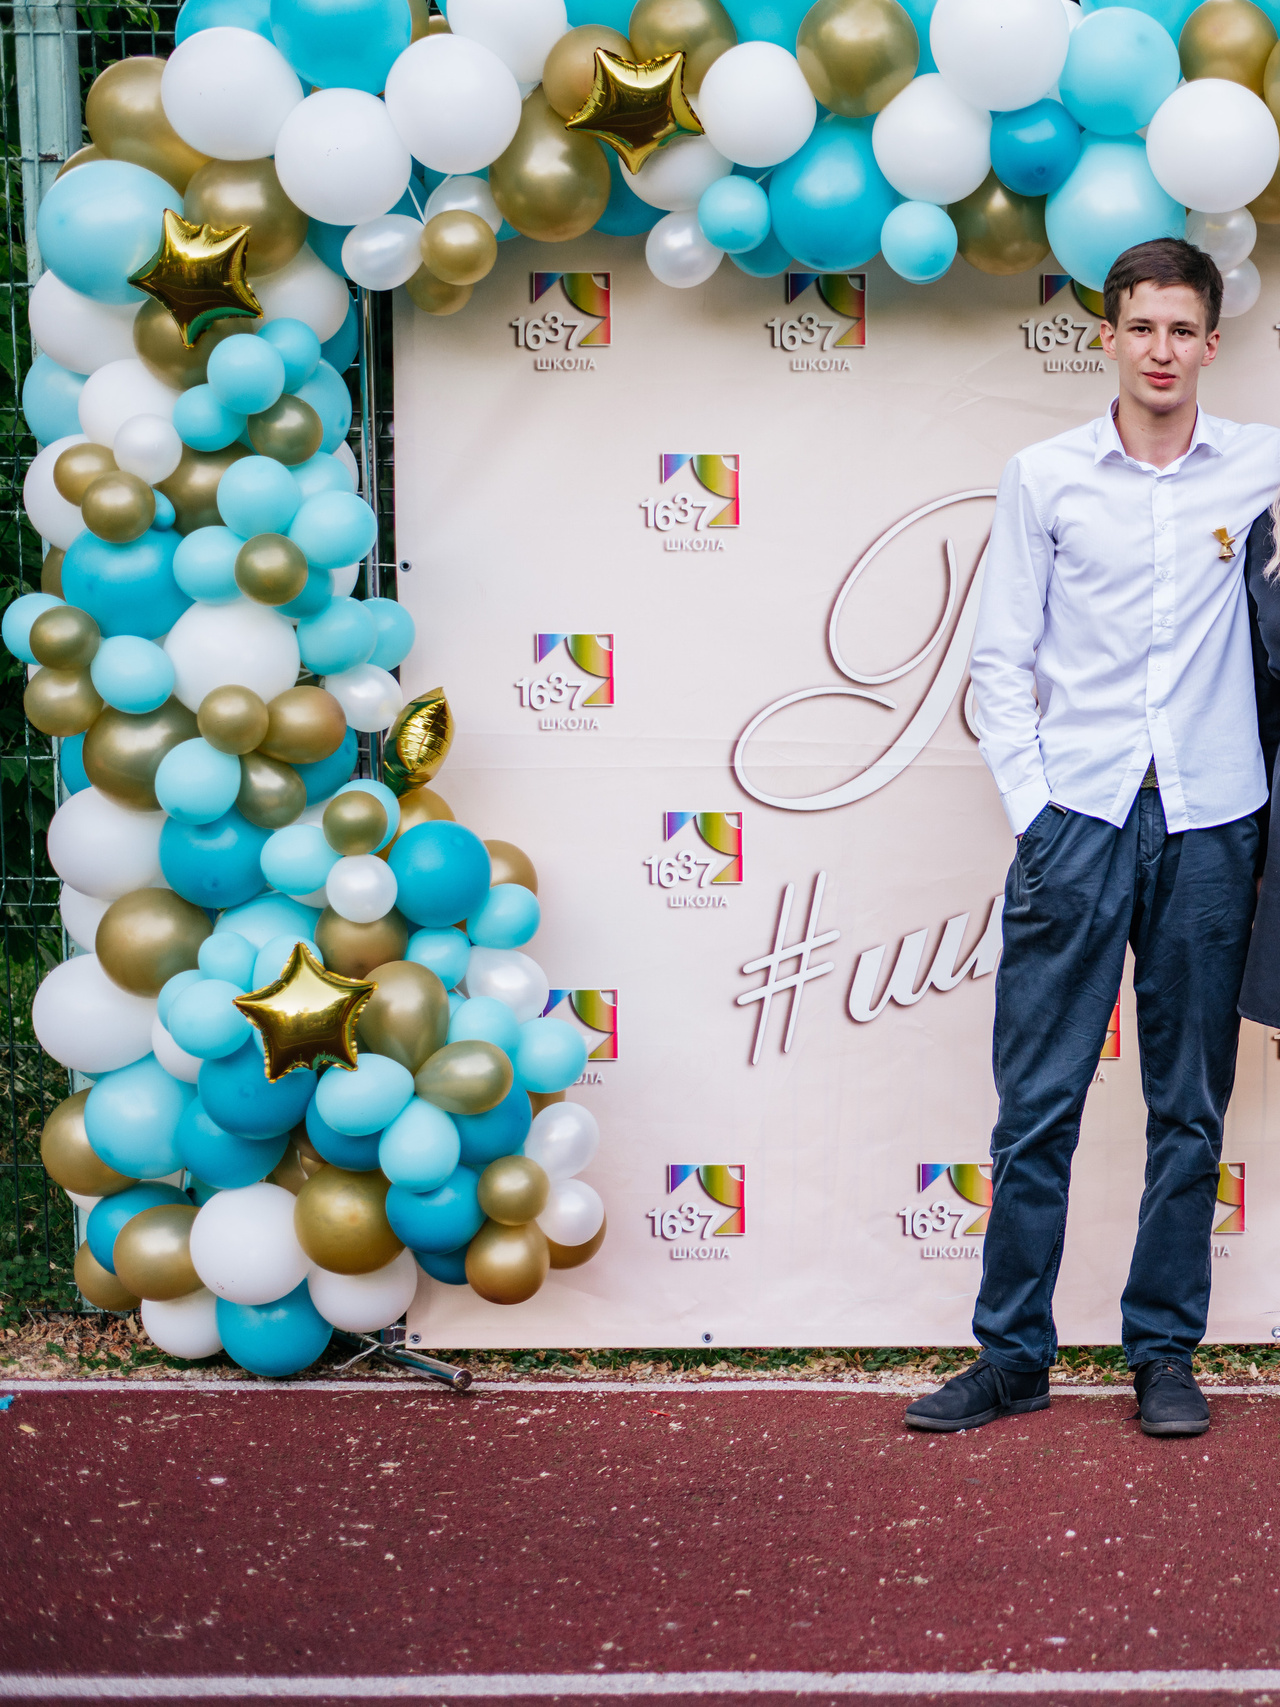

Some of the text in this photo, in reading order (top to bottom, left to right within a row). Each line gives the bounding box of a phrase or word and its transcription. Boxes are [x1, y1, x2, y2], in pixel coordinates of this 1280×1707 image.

[511, 311, 584, 350] 1637
[767, 312, 840, 351] 1637
[1021, 313, 1094, 352] 1637
[536, 357, 597, 371] ШКОЛА
[792, 358, 852, 372] ШКОЛА
[1046, 359, 1106, 373] ШКОЛА
[641, 492, 714, 531] 1637
[665, 538, 726, 552] ШКОЛА
[516, 672, 587, 710] 1637
[540, 717, 601, 731] ШКОЛА
[644, 849, 717, 888] 1637
[669, 895, 729, 909] ШКОЛА
[648, 1202, 719, 1240] 1637
[899, 1201, 969, 1238] 1637
[672, 1247, 730, 1260] ШКОЛА
[923, 1246, 981, 1258] ШКОЛА
